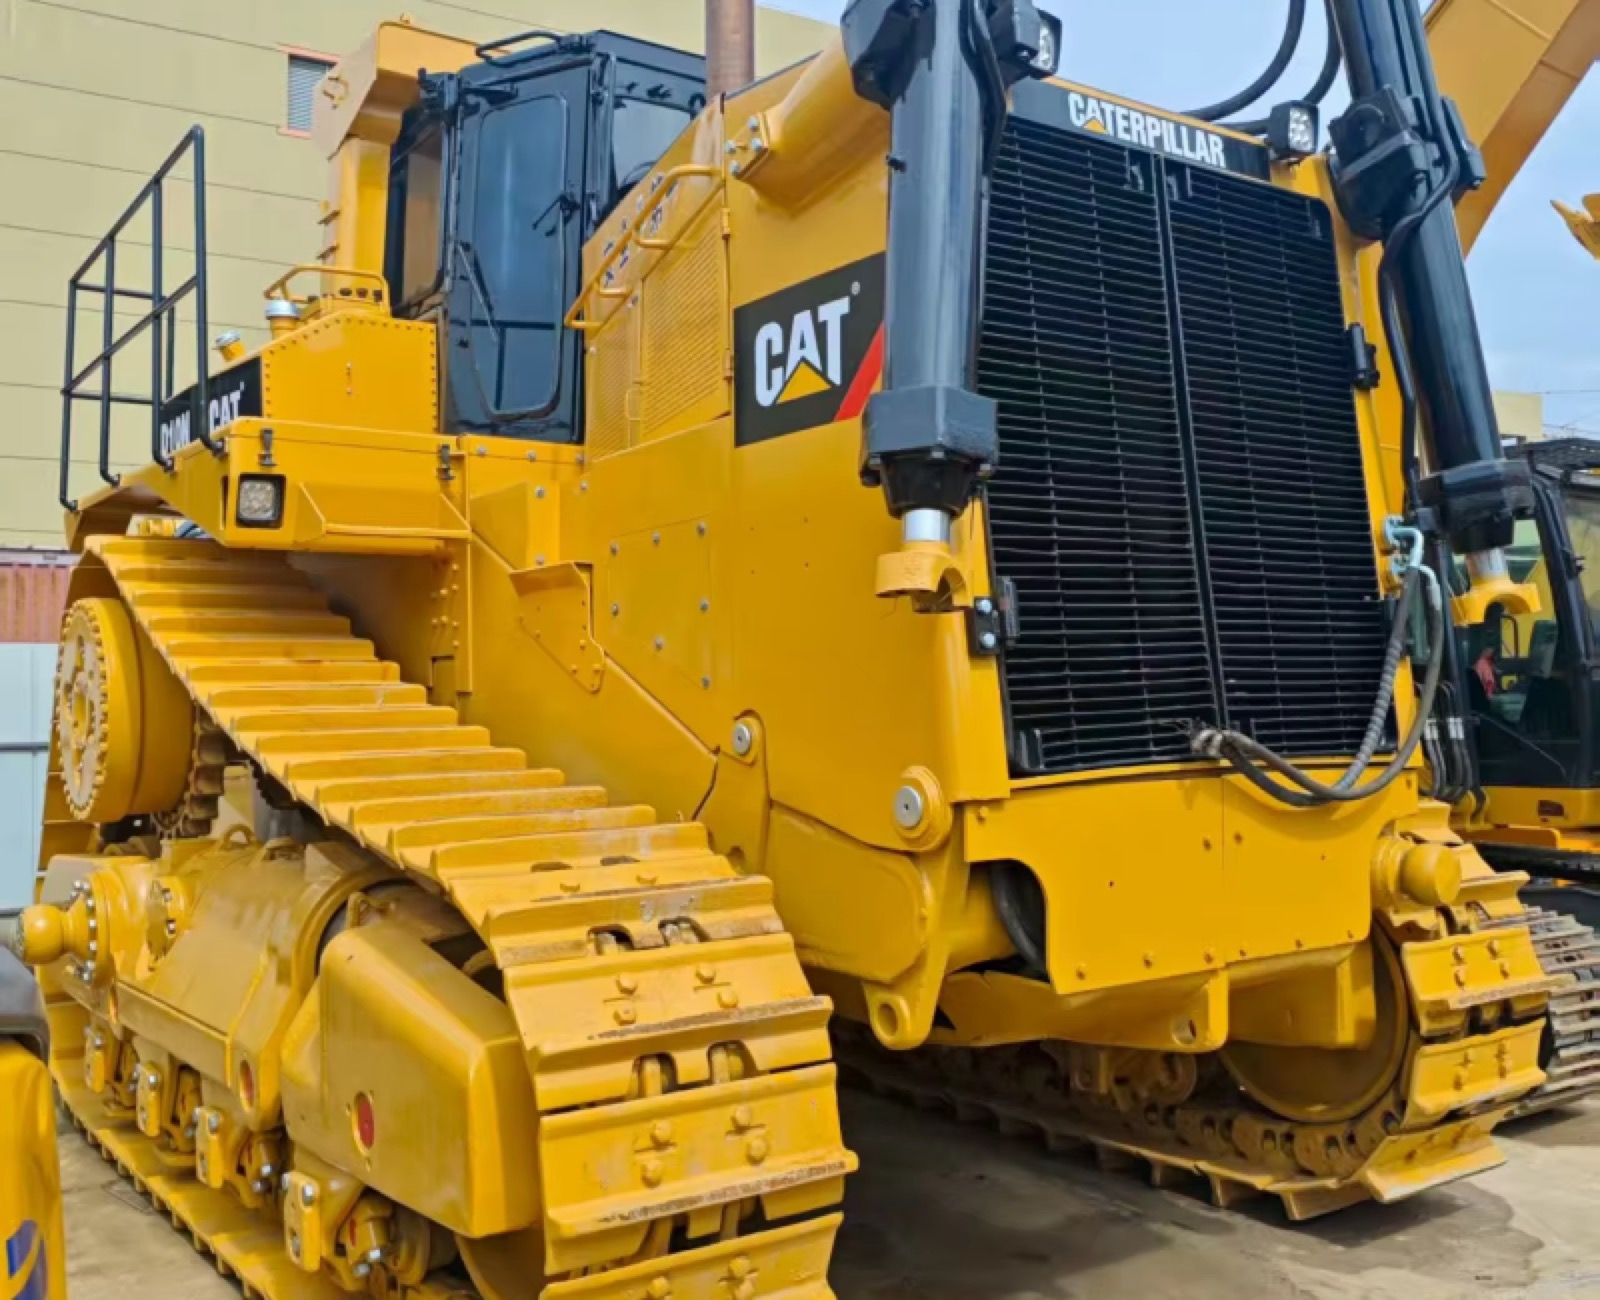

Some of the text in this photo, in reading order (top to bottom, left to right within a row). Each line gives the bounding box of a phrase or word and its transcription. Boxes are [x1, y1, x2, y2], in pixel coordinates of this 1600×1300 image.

[1067, 92, 1226, 168] CATERPILLAR
[755, 296, 850, 407] CAT
[209, 390, 240, 436] CAT
